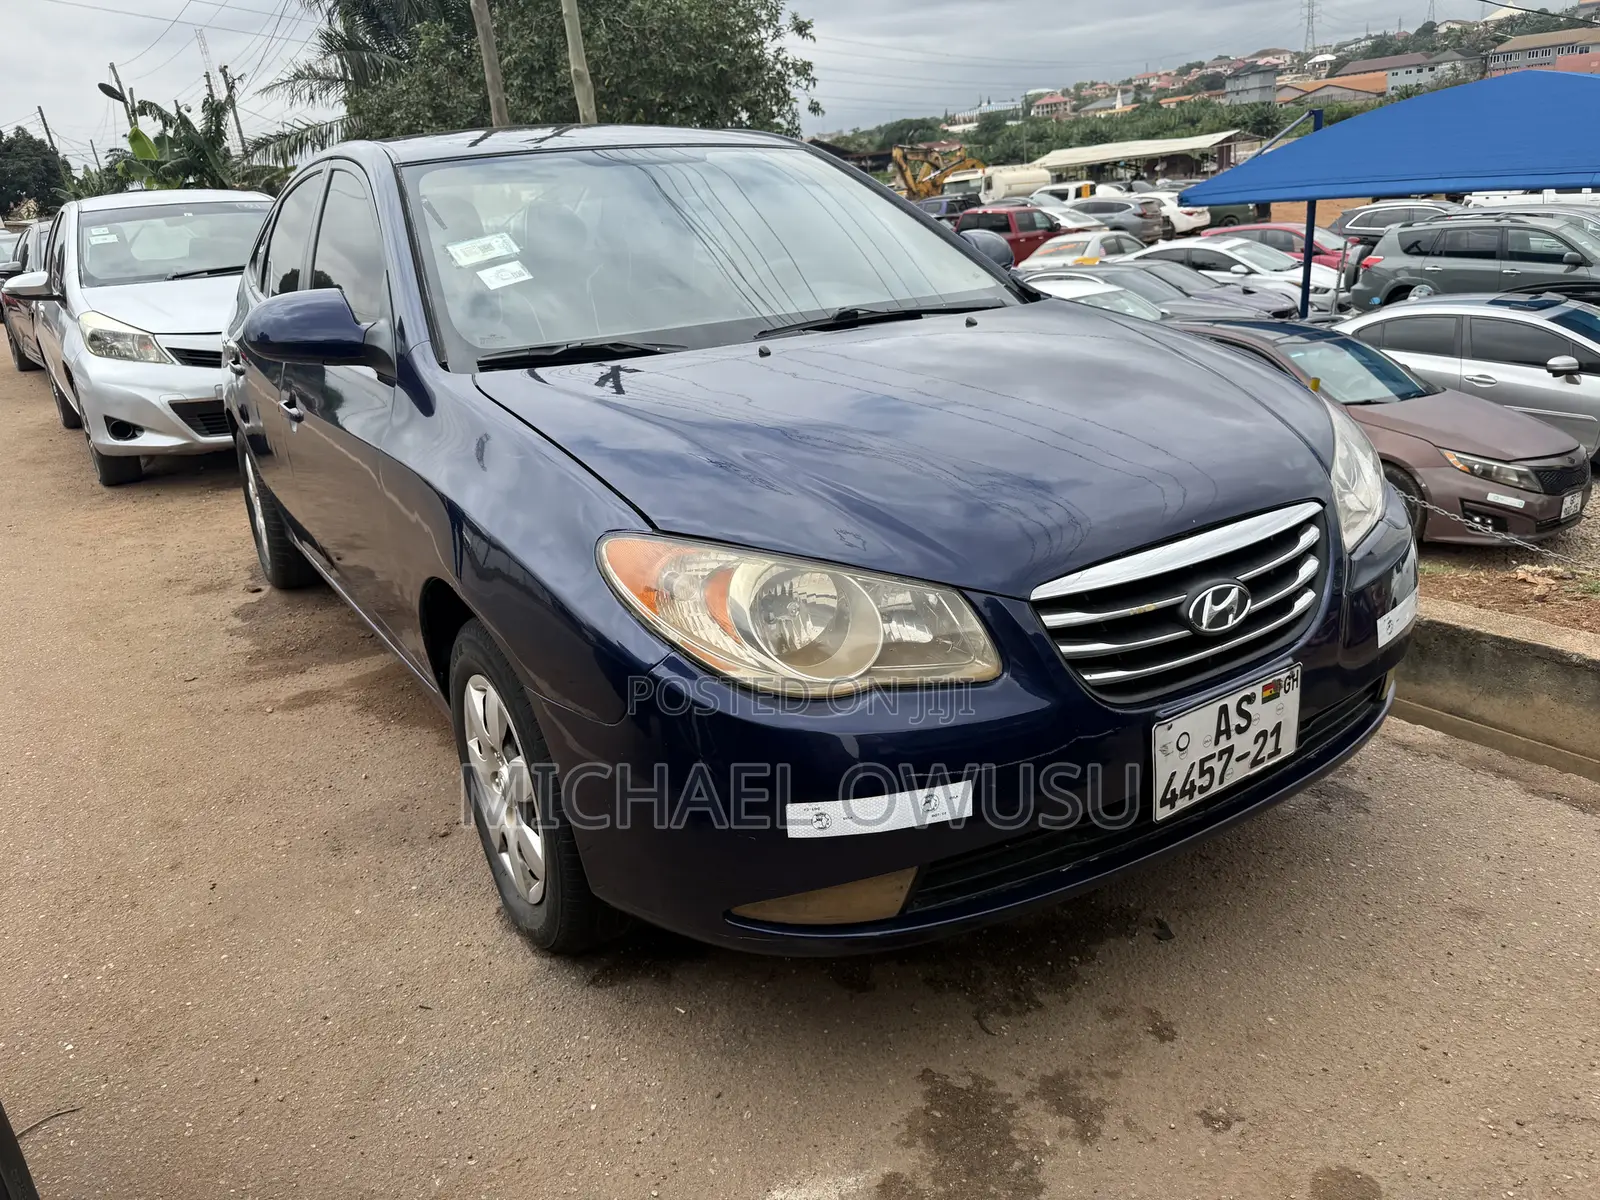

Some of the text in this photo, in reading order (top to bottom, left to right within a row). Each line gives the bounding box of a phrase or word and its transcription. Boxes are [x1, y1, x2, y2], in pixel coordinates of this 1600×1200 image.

[1283, 669, 1300, 694] GH
[1213, 693, 1254, 747] AS
[1159, 720, 1283, 811] 4457-21
